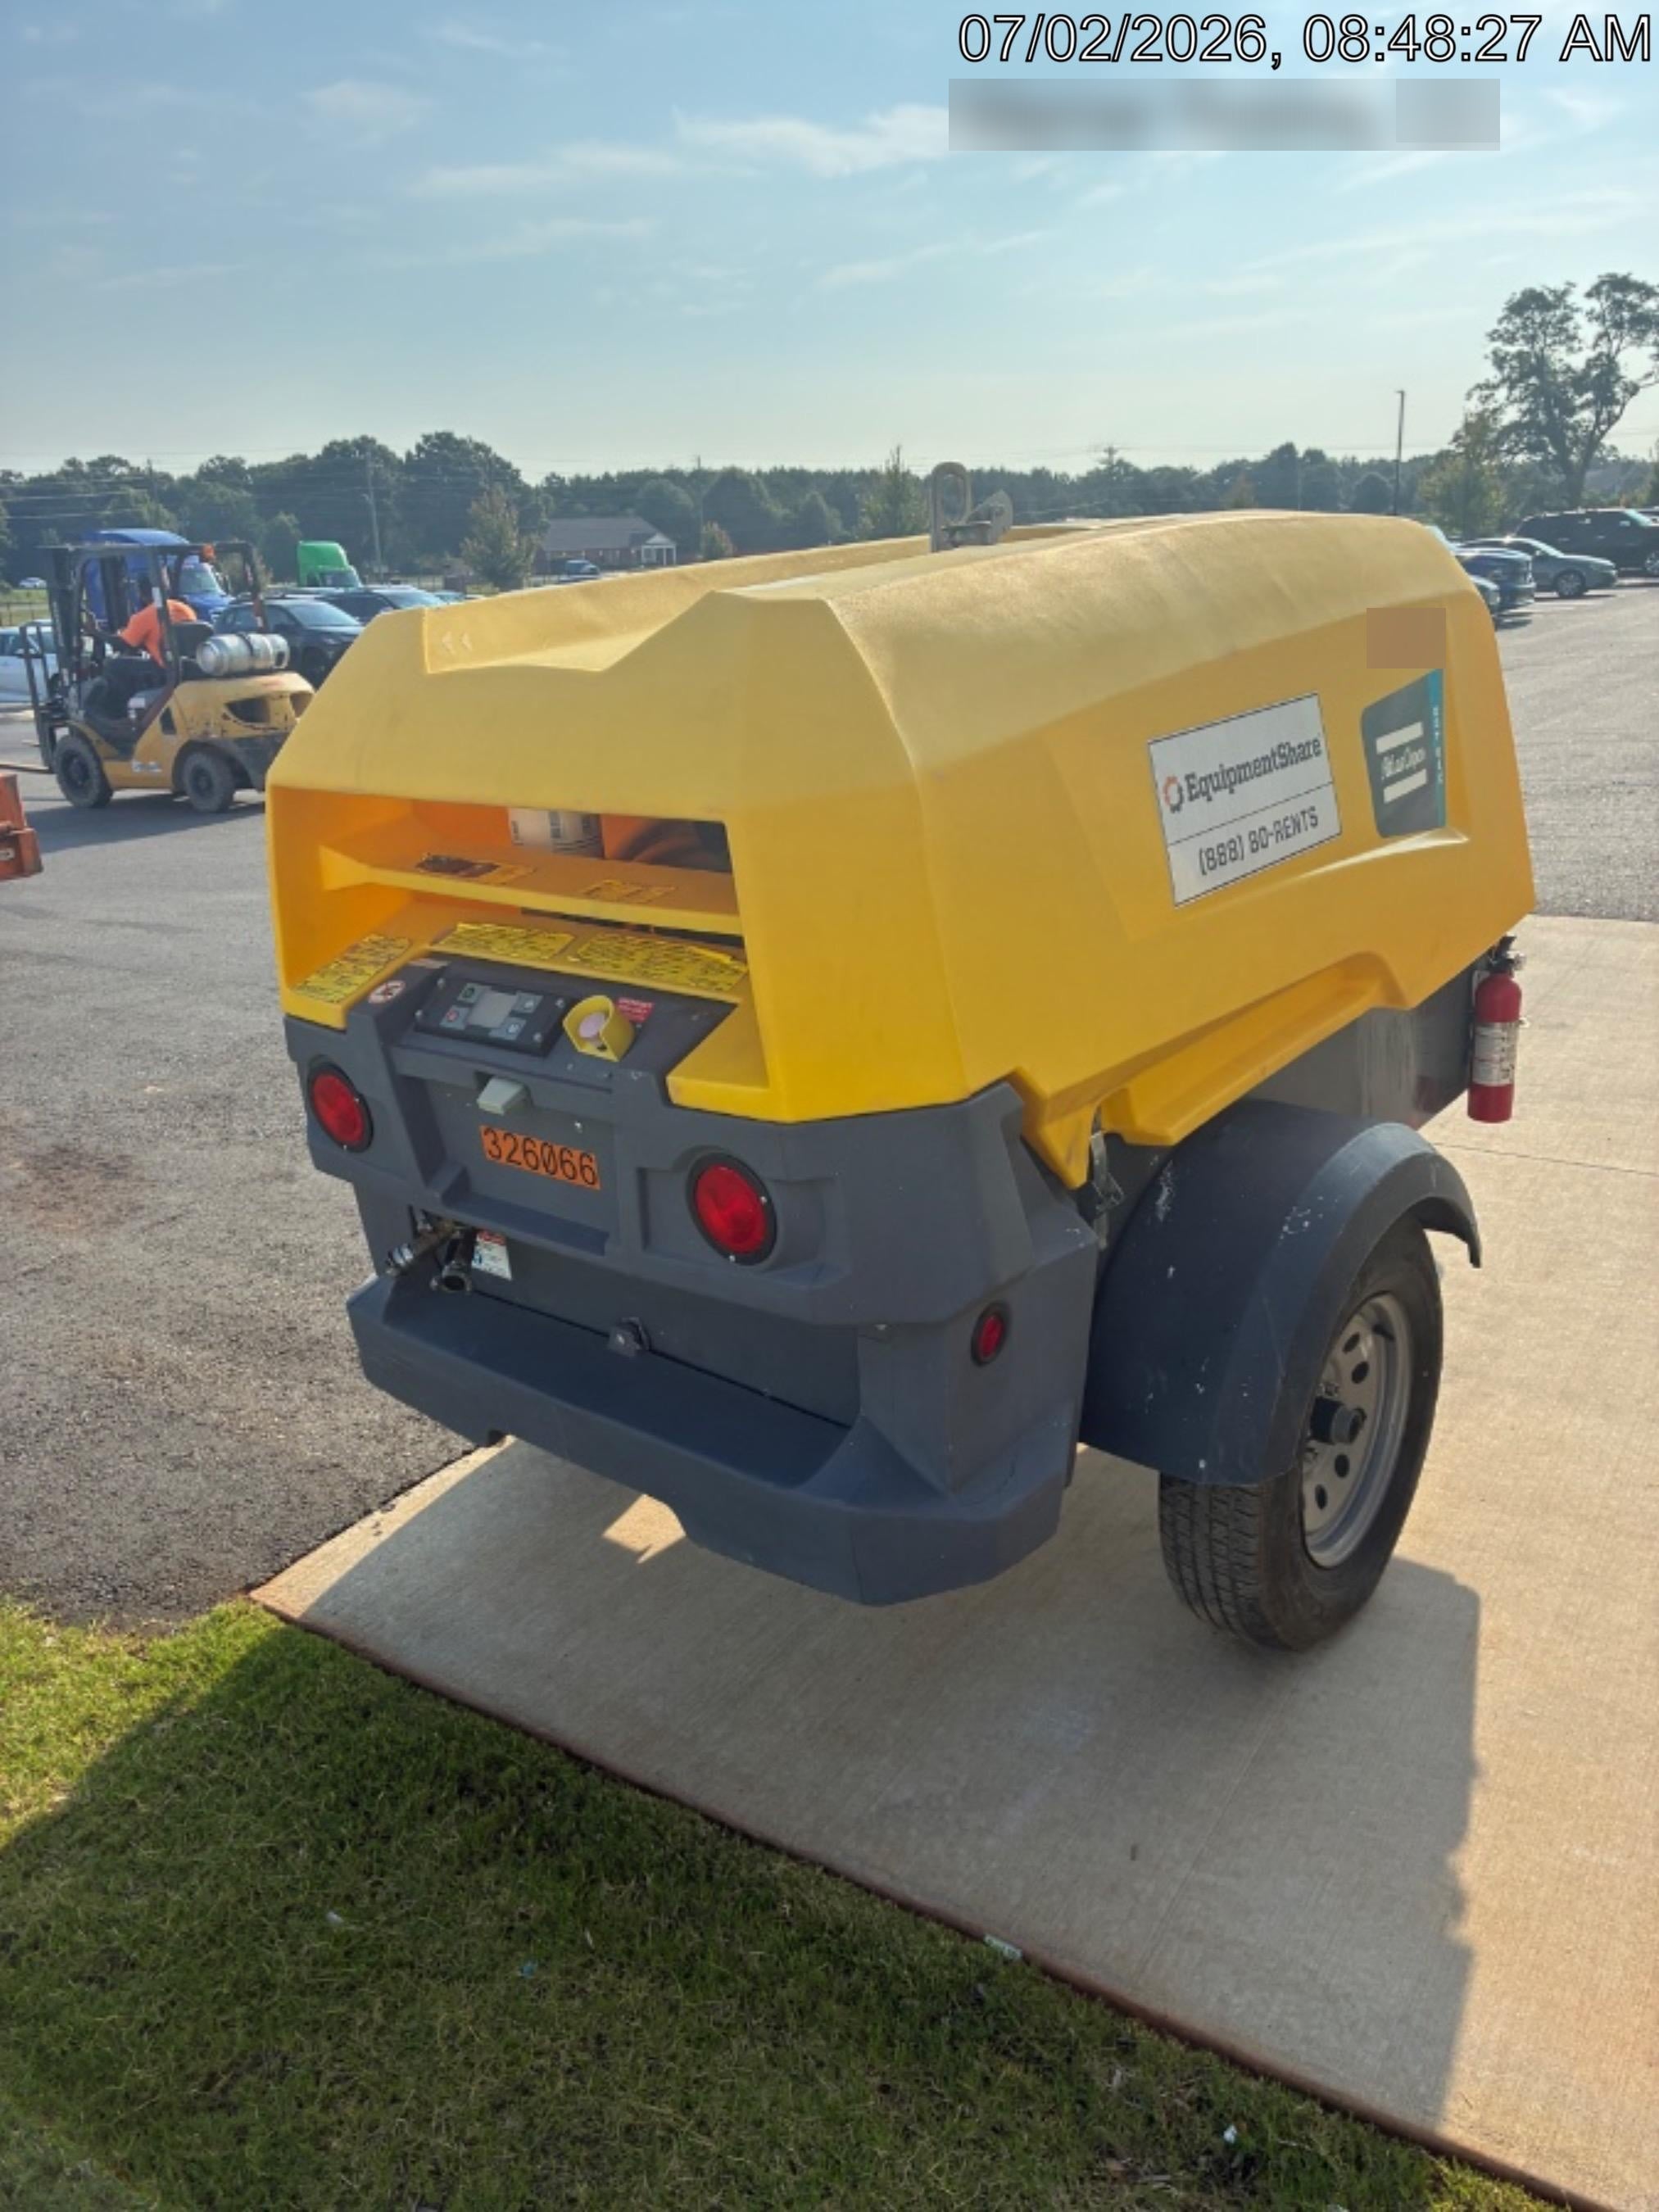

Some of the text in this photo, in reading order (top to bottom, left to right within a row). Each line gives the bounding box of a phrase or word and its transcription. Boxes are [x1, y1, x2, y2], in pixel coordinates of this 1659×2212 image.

[1185, 737, 1323, 802] EquipmentShare
[1199, 834, 1245, 877] (888)
[483, 1126, 600, 1186] 326066
